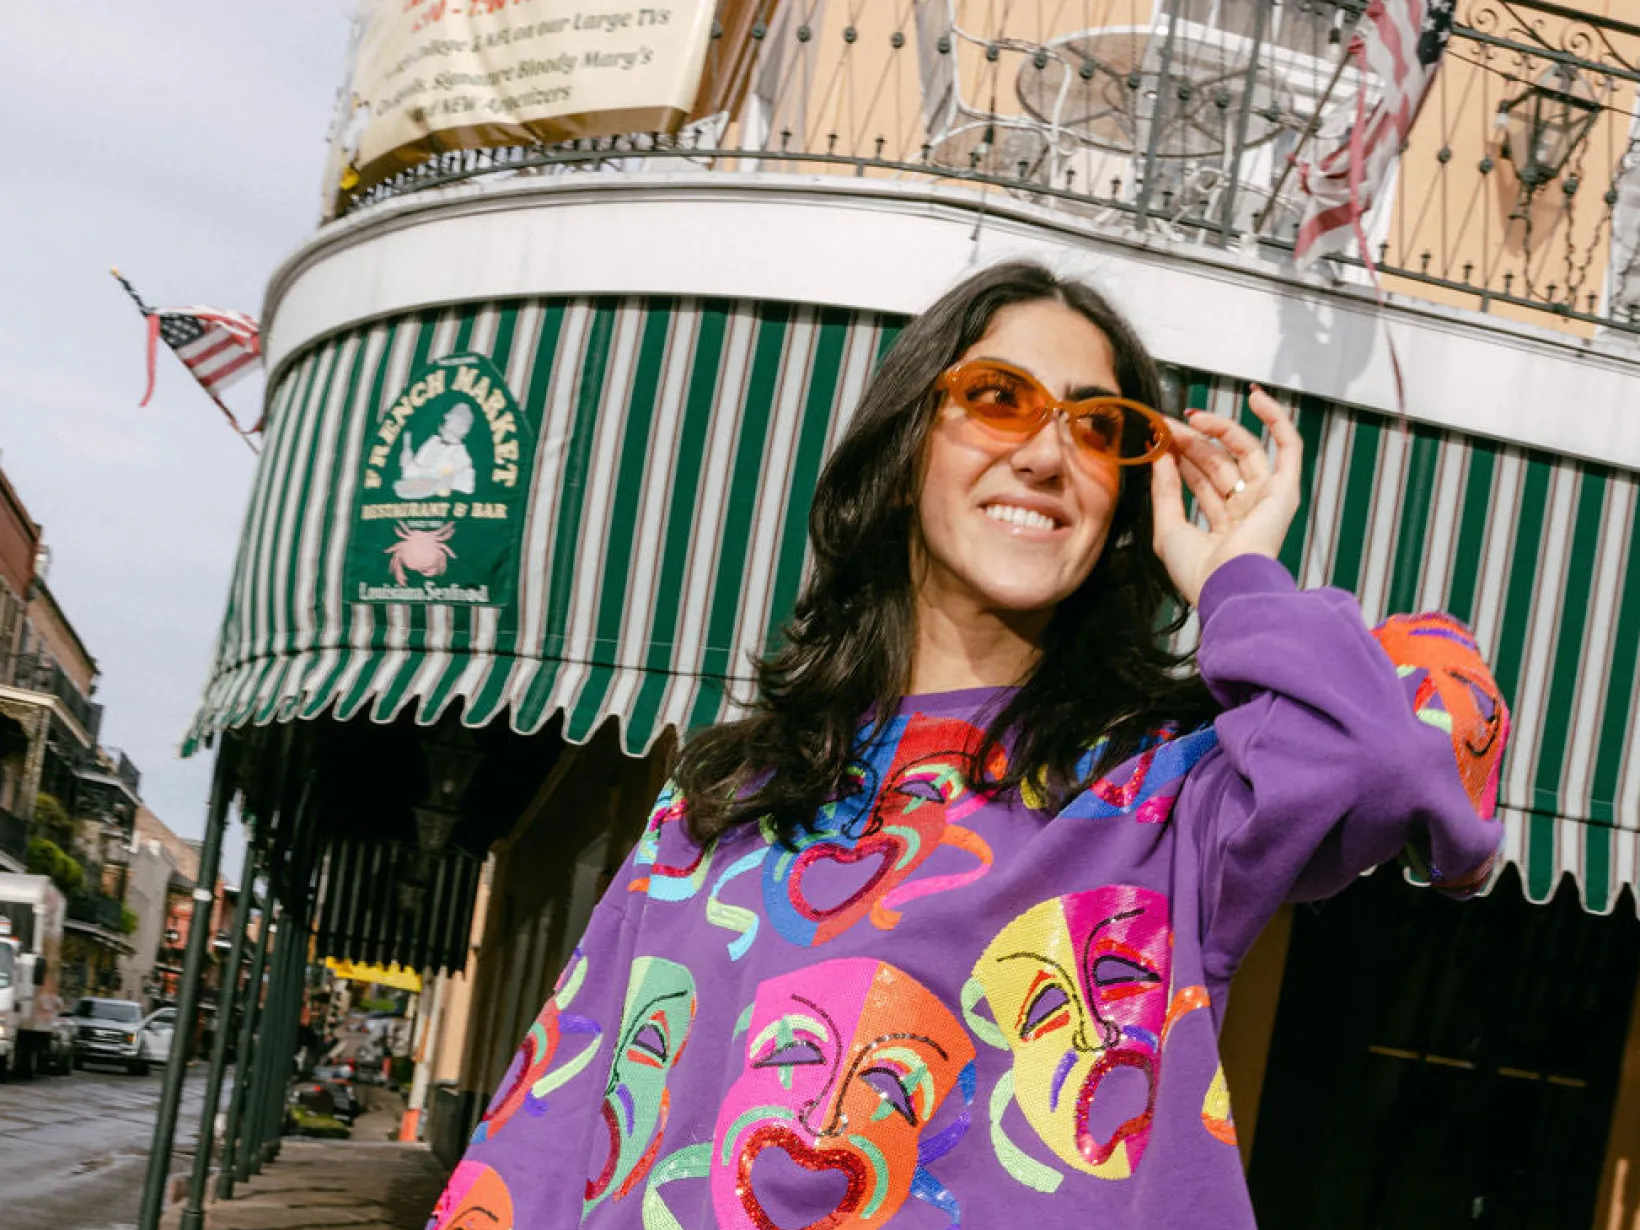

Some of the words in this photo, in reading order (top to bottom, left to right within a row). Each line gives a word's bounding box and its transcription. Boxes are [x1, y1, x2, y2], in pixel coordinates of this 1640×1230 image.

[535, 17, 571, 37] our
[572, 12, 634, 33] Large
[517, 52, 578, 79] Bloody
[583, 46, 653, 70] Mary's
[363, 369, 446, 489] FRENCH
[451, 365, 520, 488] MARKET
[361, 502, 450, 519] RESTAURANT
[453, 502, 469, 518] &
[471, 502, 508, 519] BAR
[425, 582, 489, 602] Seafood
